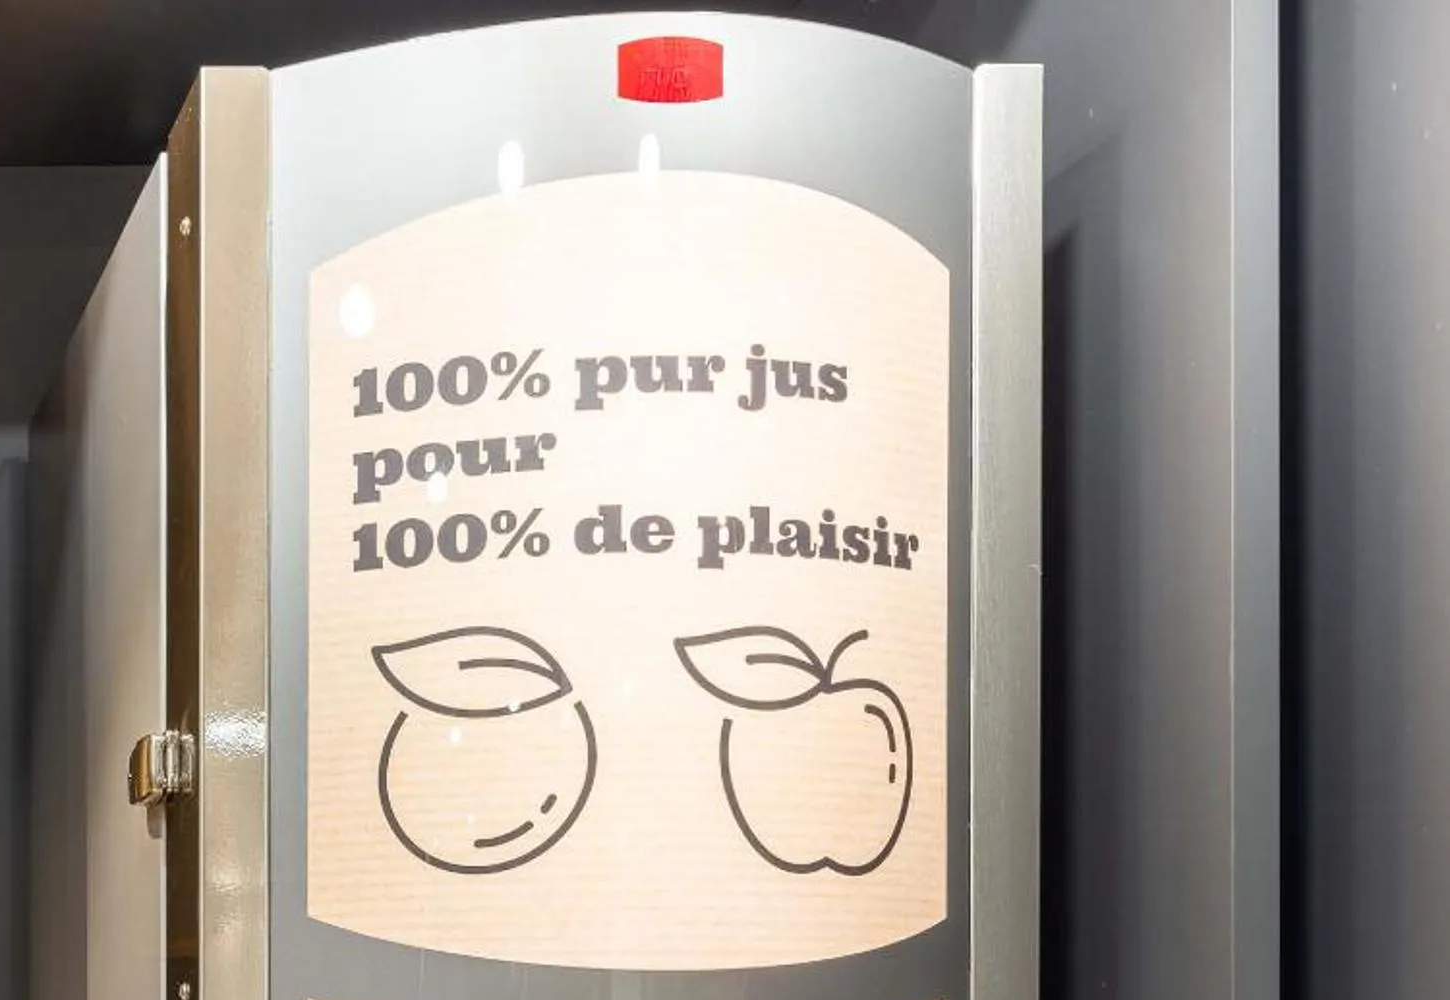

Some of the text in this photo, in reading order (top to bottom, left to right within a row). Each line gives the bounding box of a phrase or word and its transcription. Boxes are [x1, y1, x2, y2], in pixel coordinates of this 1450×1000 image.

[352, 343, 849, 418] 100% pur jus
[352, 431, 558, 505] pour
[352, 504, 920, 573] 100% de plaisir
